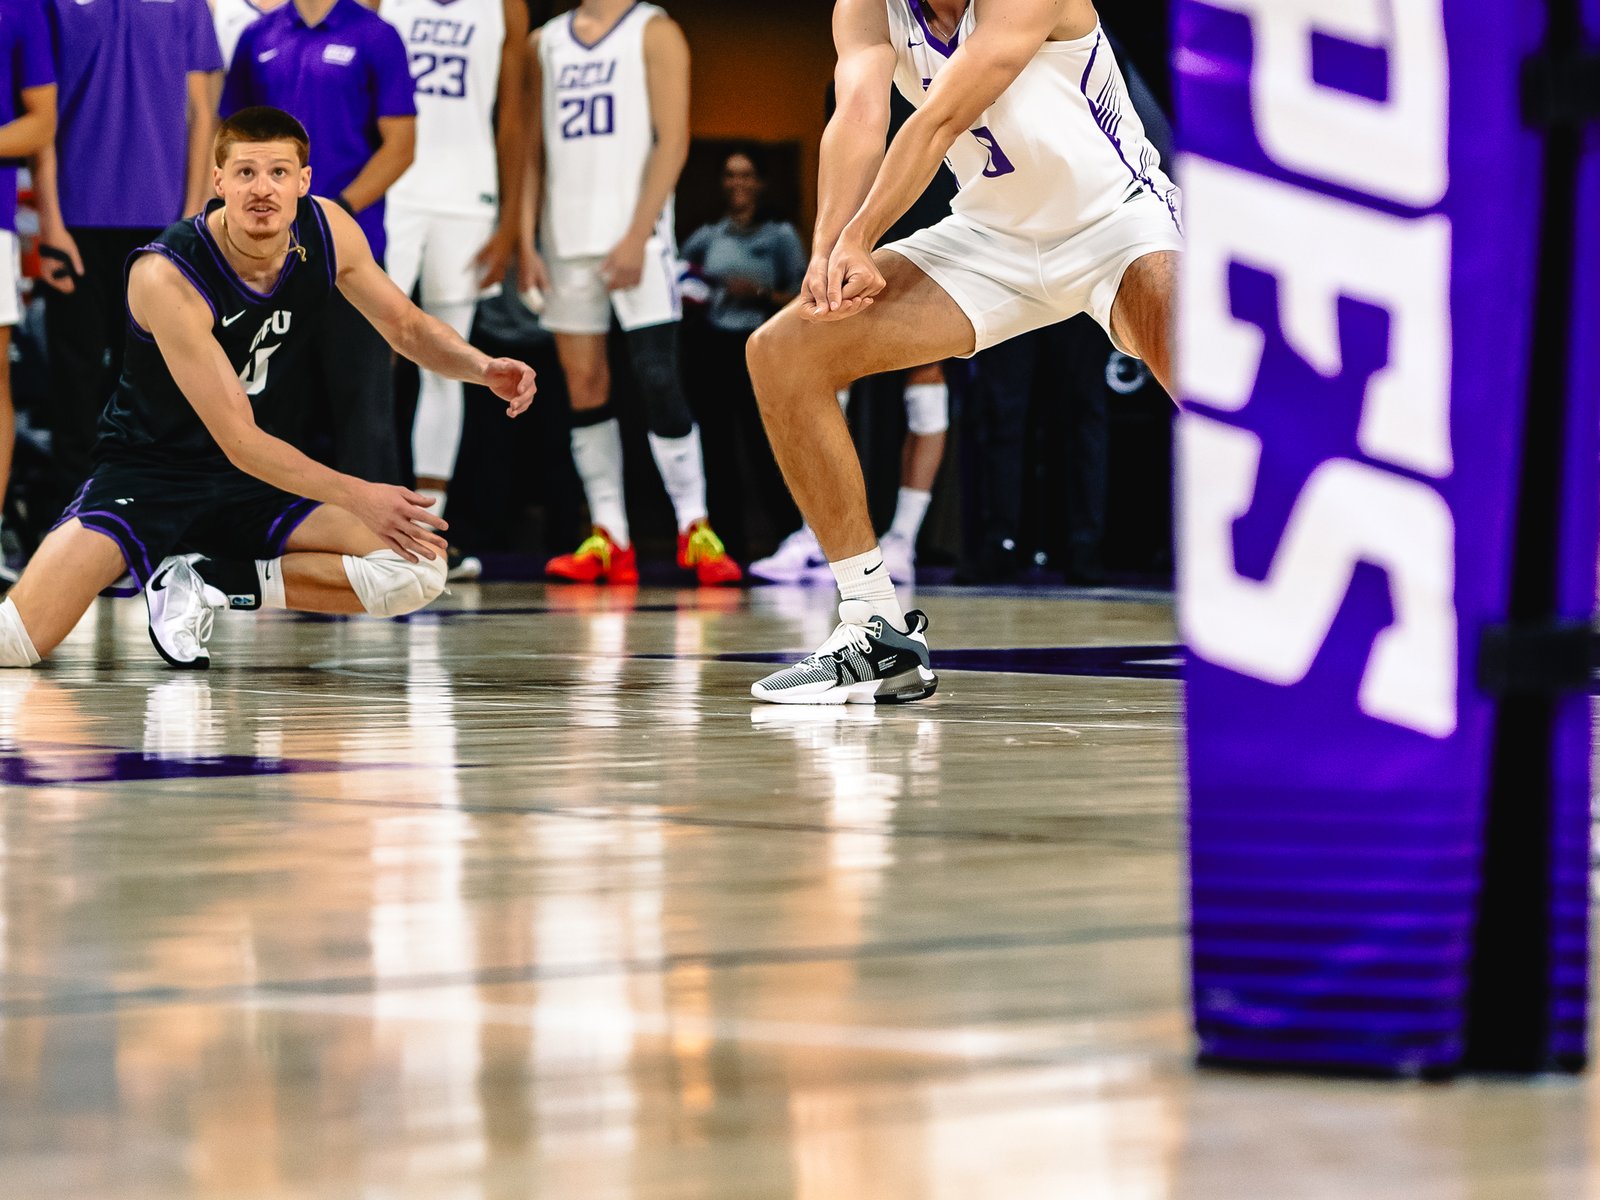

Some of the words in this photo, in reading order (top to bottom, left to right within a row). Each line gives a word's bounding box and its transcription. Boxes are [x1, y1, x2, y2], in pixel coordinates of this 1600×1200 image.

[410, 18, 476, 47] GCU
[412, 53, 467, 98] 23
[557, 59, 617, 89] GCU
[560, 94, 615, 140] 20
